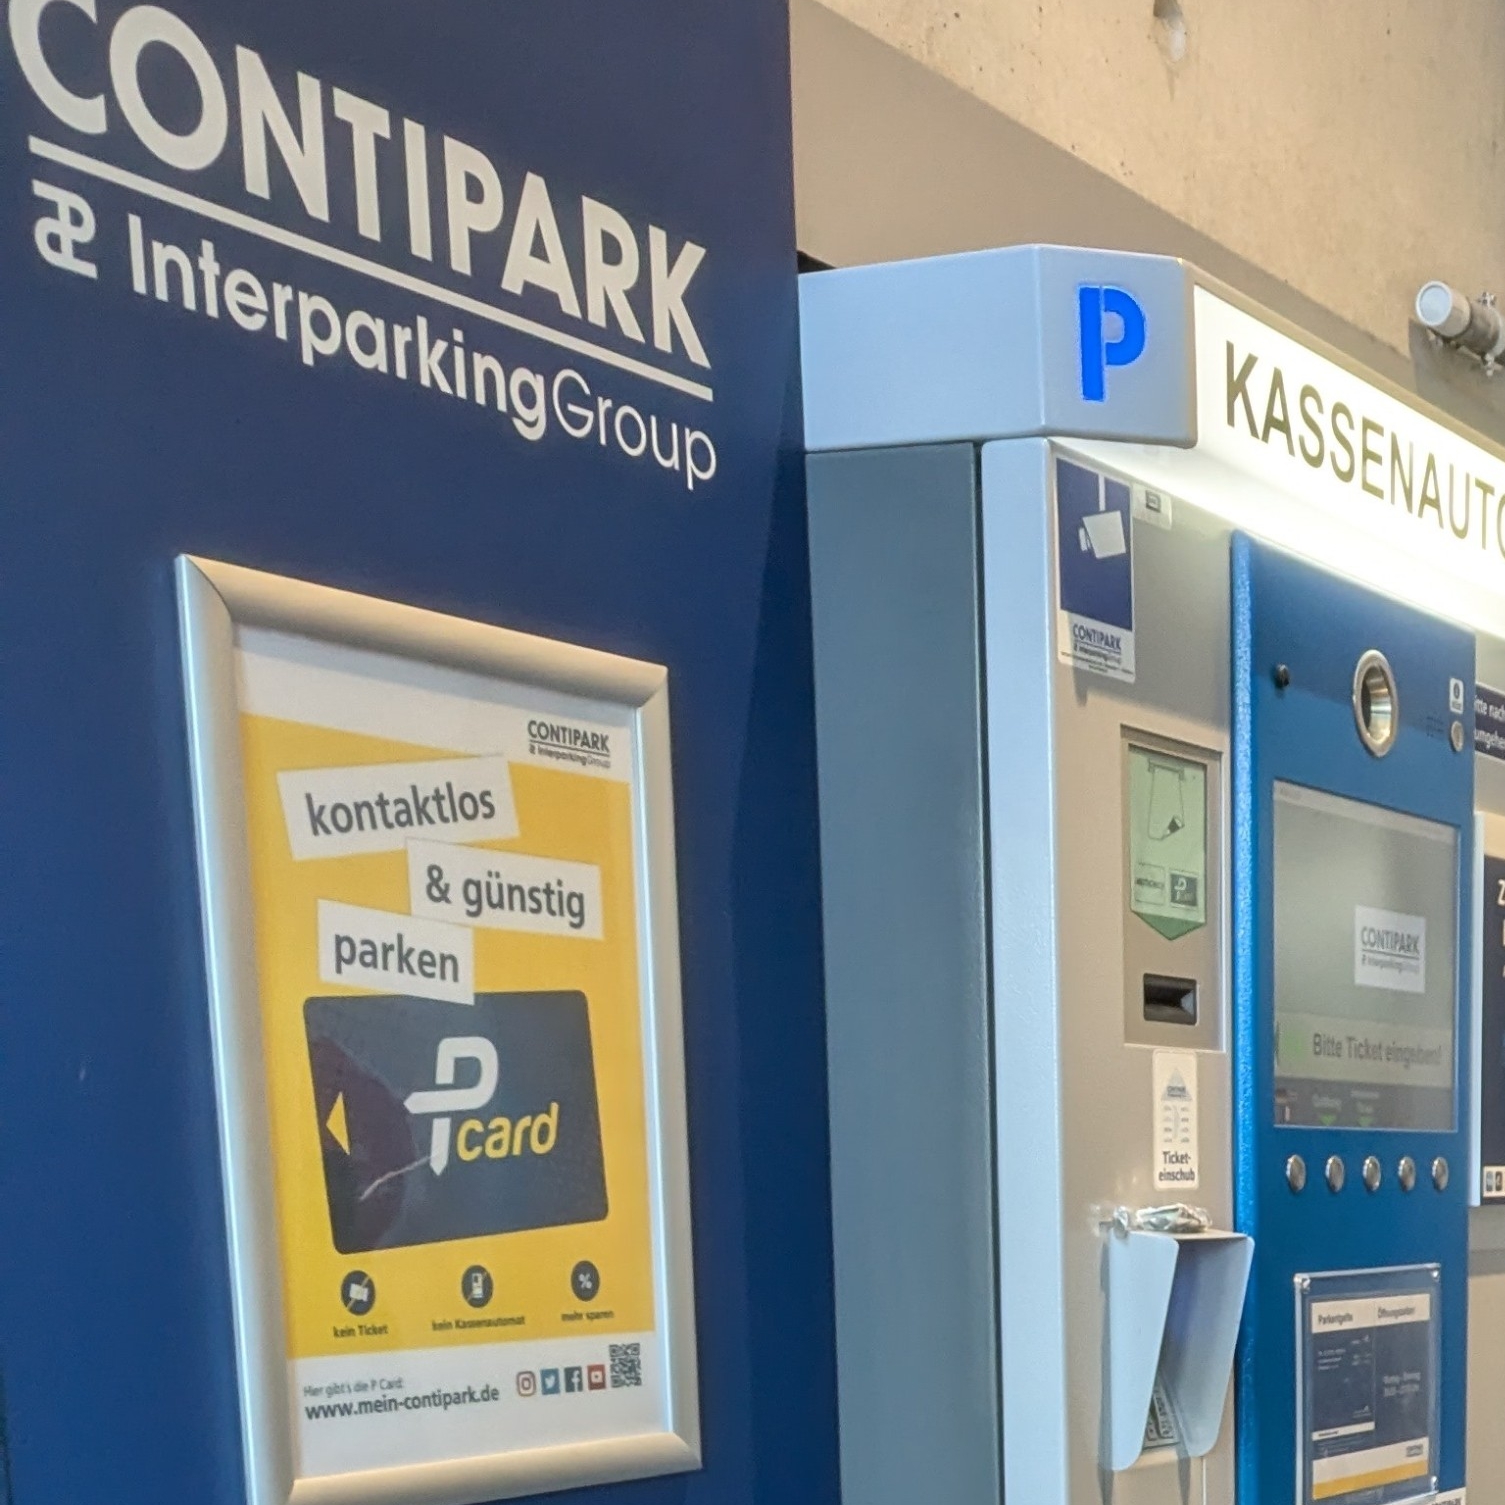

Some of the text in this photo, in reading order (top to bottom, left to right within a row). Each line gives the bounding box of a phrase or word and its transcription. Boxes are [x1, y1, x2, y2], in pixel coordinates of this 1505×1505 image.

[8, 0, 711, 369] CONTIPARK
[1078, 286, 1147, 402] P
[1474, 694, 1488, 716] itte
[528, 720, 610, 753] CONTIPARK
[305, 781, 496, 837] kontaktlos
[425, 864, 586, 929] & günstig
[1361, 926, 1419, 954] CONTIPARK
[333, 932, 460, 983] parken
[1313, 1033, 1342, 1057] Bitte
[1346, 1036, 1382, 1061] Ticket
[456, 1102, 559, 1162] card
[1163, 1151, 1191, 1164] Ticket-
[1159, 1167, 1196, 1181] einschub
[333, 1324, 388, 1338] kein Ticket
[432, 1319, 452, 1331] kein
[303, 1385, 323, 1397] Hier
[353, 1380, 369, 1392] die
[305, 1384, 500, 1420] www.mein-contipark.de
